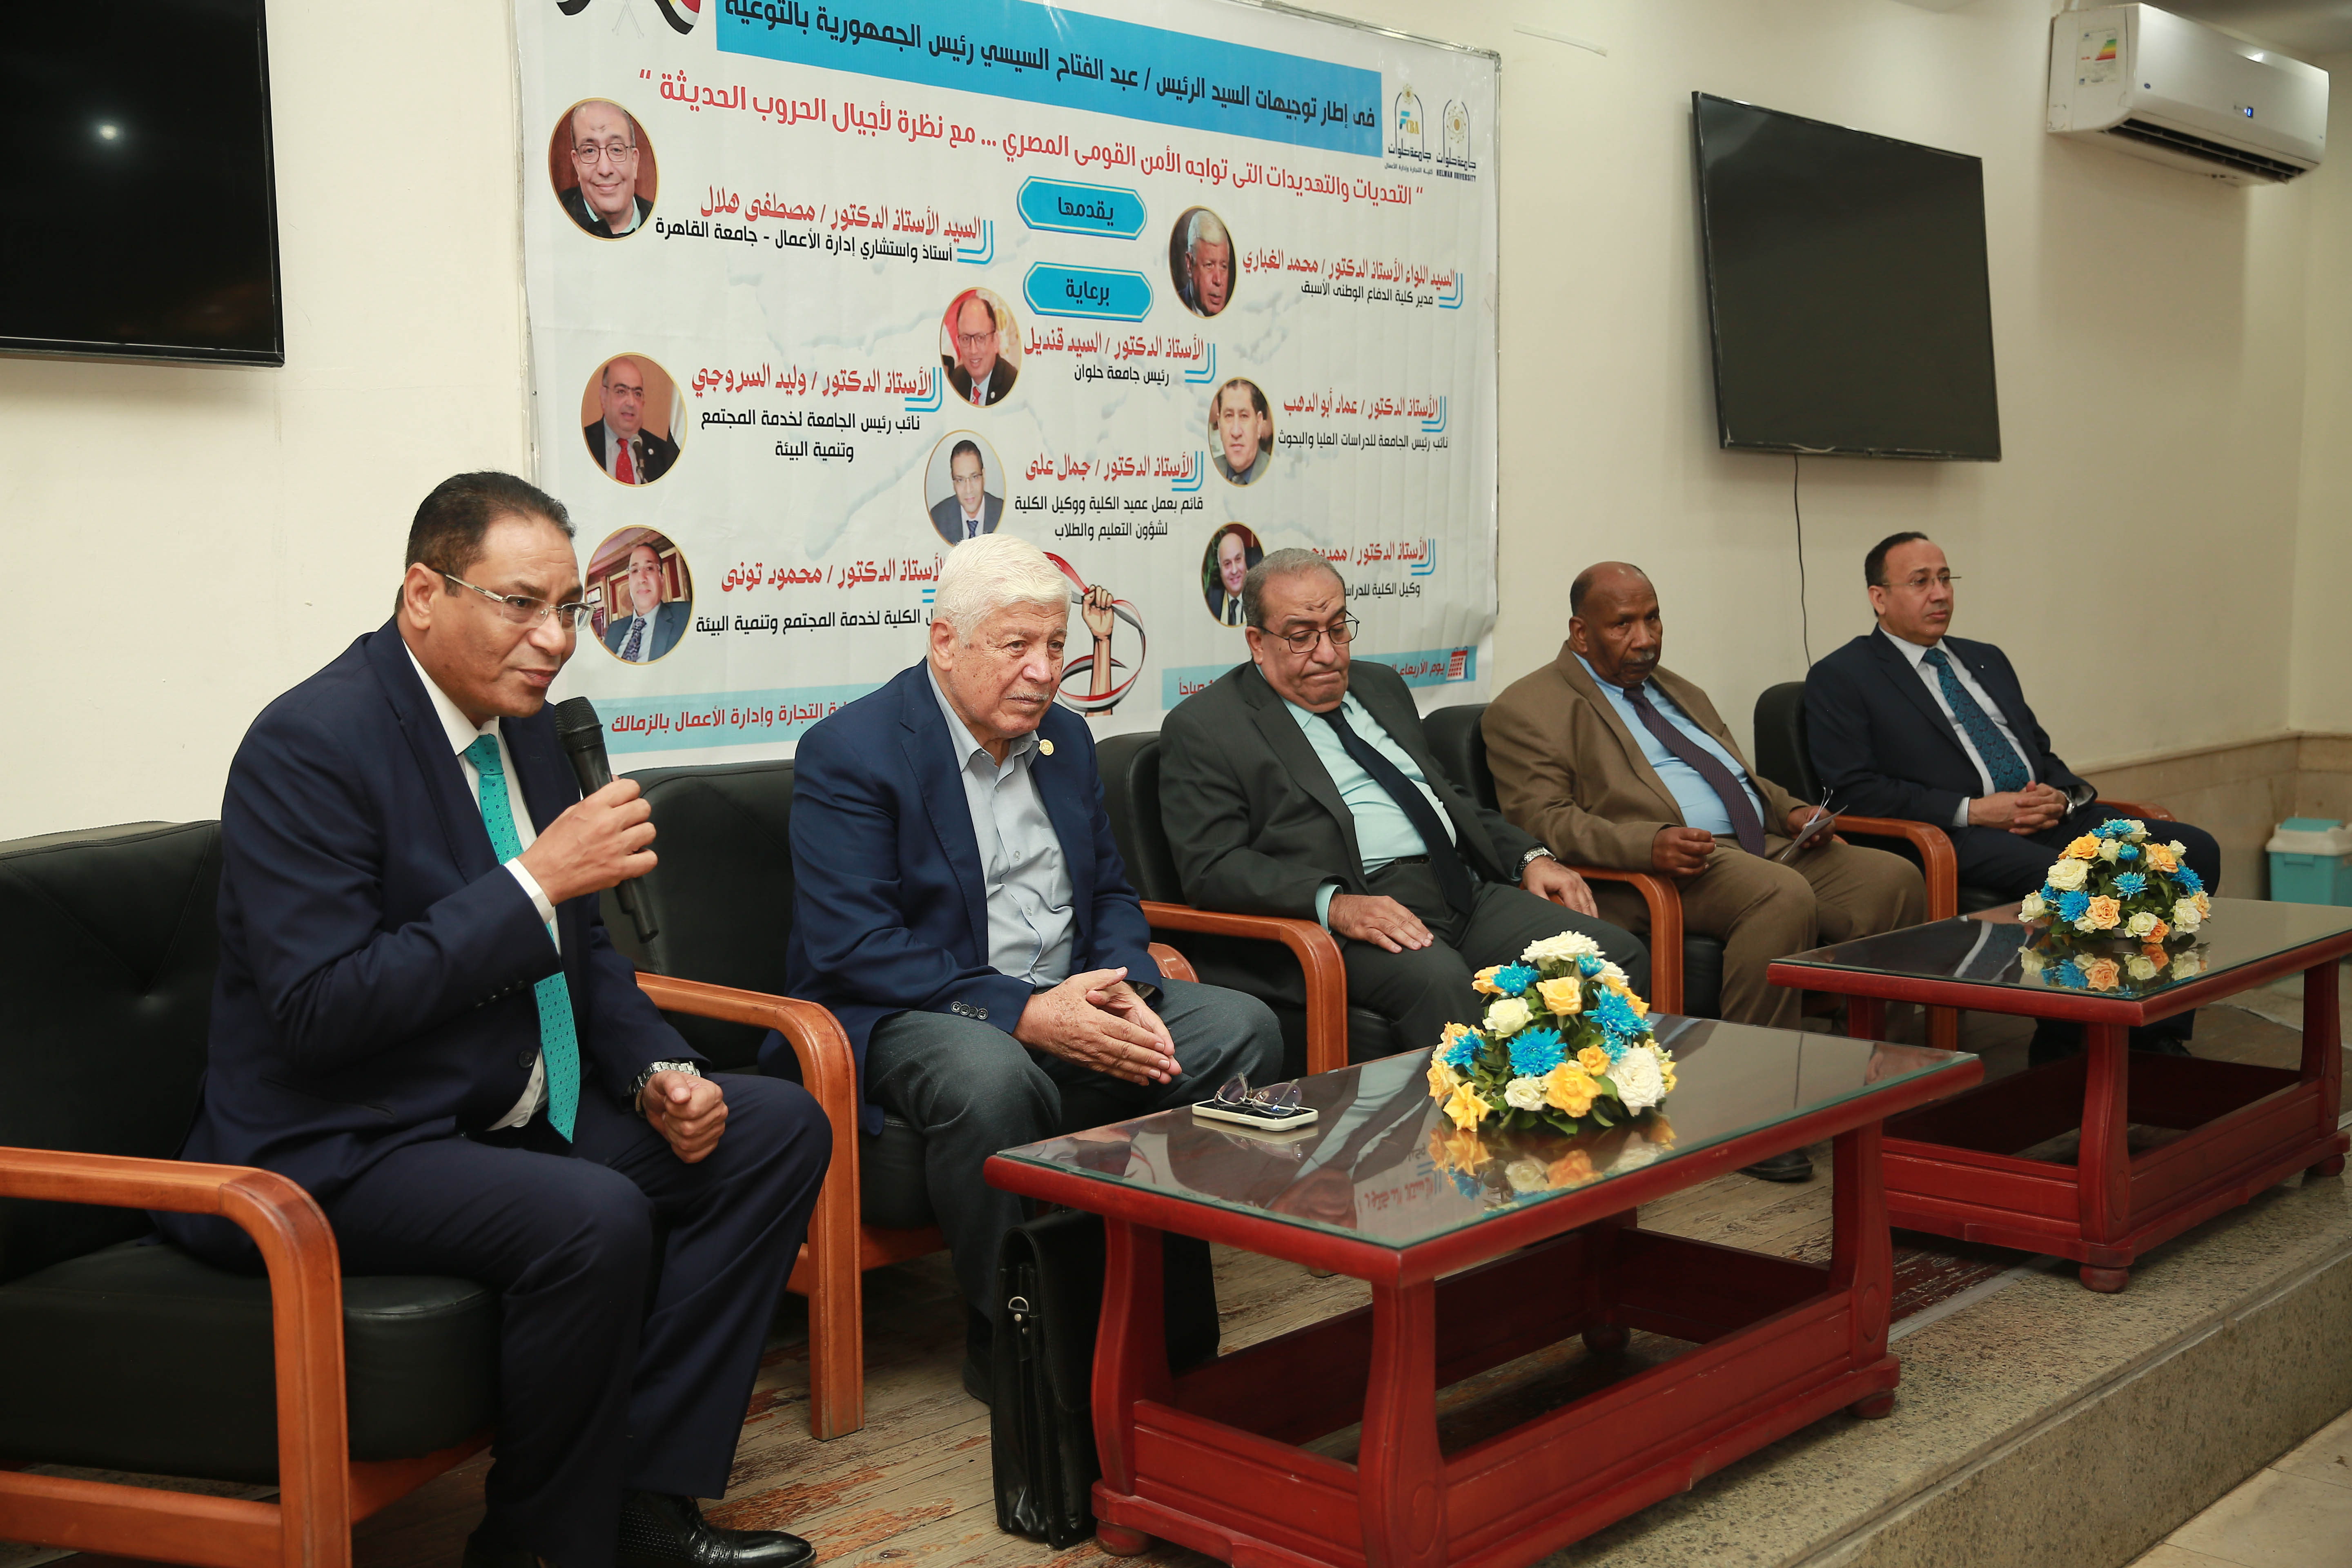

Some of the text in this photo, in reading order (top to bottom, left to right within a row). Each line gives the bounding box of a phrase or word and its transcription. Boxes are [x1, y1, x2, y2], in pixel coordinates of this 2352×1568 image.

[817, 7, 920, 51] الجمهورية
[929, 36, 973, 65] رئيس
[981, 45, 1048, 72] السيسي
[1057, 53, 1103, 82] الفتاح
[1111, 68, 1137, 91] عبد
[1145, 68, 1150, 90] /
[660, 70, 746, 111] الحديثة
[1157, 77, 1205, 103] الرئيس
[1212, 85, 1249, 108] السيد
[753, 97, 826, 125] الحروب
[833, 101, 891, 136] لأجيال
[1256, 90, 1316, 122] توجيهات
[1321, 101, 1348, 128] إطار
[950, 125, 976, 149] مع
[1003, 133, 1068, 162] المصري
[1141, 145, 1181, 175] الأمن
[1186, 158, 1227, 185] تواجه
[1267, 169, 1349, 203] والتهديدات
[1354, 179, 1411, 206] التحديات
[701, 185, 981, 243] السيد الأستاذ الدكتور / مصطفى هلال
[1059, 197, 1113, 226] يقدمها
[656, 218, 708, 239] القاهرة
[715, 223, 757, 242] جامعة
[776, 228, 820, 249] الأعمال
[826, 235, 854, 256] إدارة
[923, 243, 951, 261] أستاذ
[1067, 279, 1109, 306] برعاية
[1024, 327, 1204, 360] الأستاذ الدكتور / السيد قنديل
[692, 363, 931, 397] الأستاذ الدكتور / وليد السروجي
[1075, 364, 1169, 386] رئيس جامعة حلوان
[702, 409, 919, 434] نائب رئيس الجامعة لخدمة المجتمع
[776, 441, 853, 463] وتنمية البيئة
[1057, 454, 1091, 481] جمال
[1095, 461, 1100, 476] /
[1104, 456, 1150, 481] الدكتور
[1154, 452, 1192, 478] الأستاذ
[1016, 496, 1203, 514] قائم بعمل عميد الكلية ووكيل الكلية
[1055, 523, 1094, 541] والطلاب
[1098, 523, 1131, 541] التعليم
[768, 568, 822, 590] محمود
[827, 565, 833, 583] /
[837, 559, 895, 589] الدكتور
[900, 552, 944, 581] لأستاذ
[1345, 584, 1369, 600] للدراس
[697, 616, 728, 636] البيئة
[735, 615, 777, 635] وتنمية
[783, 612, 835, 635] المجتمع
[841, 611, 879, 626] لخدمة
[885, 609, 920, 628] الكلية
[611, 713, 670, 736] بالزمالك
[675, 706, 726, 732] الأعمال
[730, 706, 774, 730] وإدارة
[779, 703, 822, 724] التجارة
